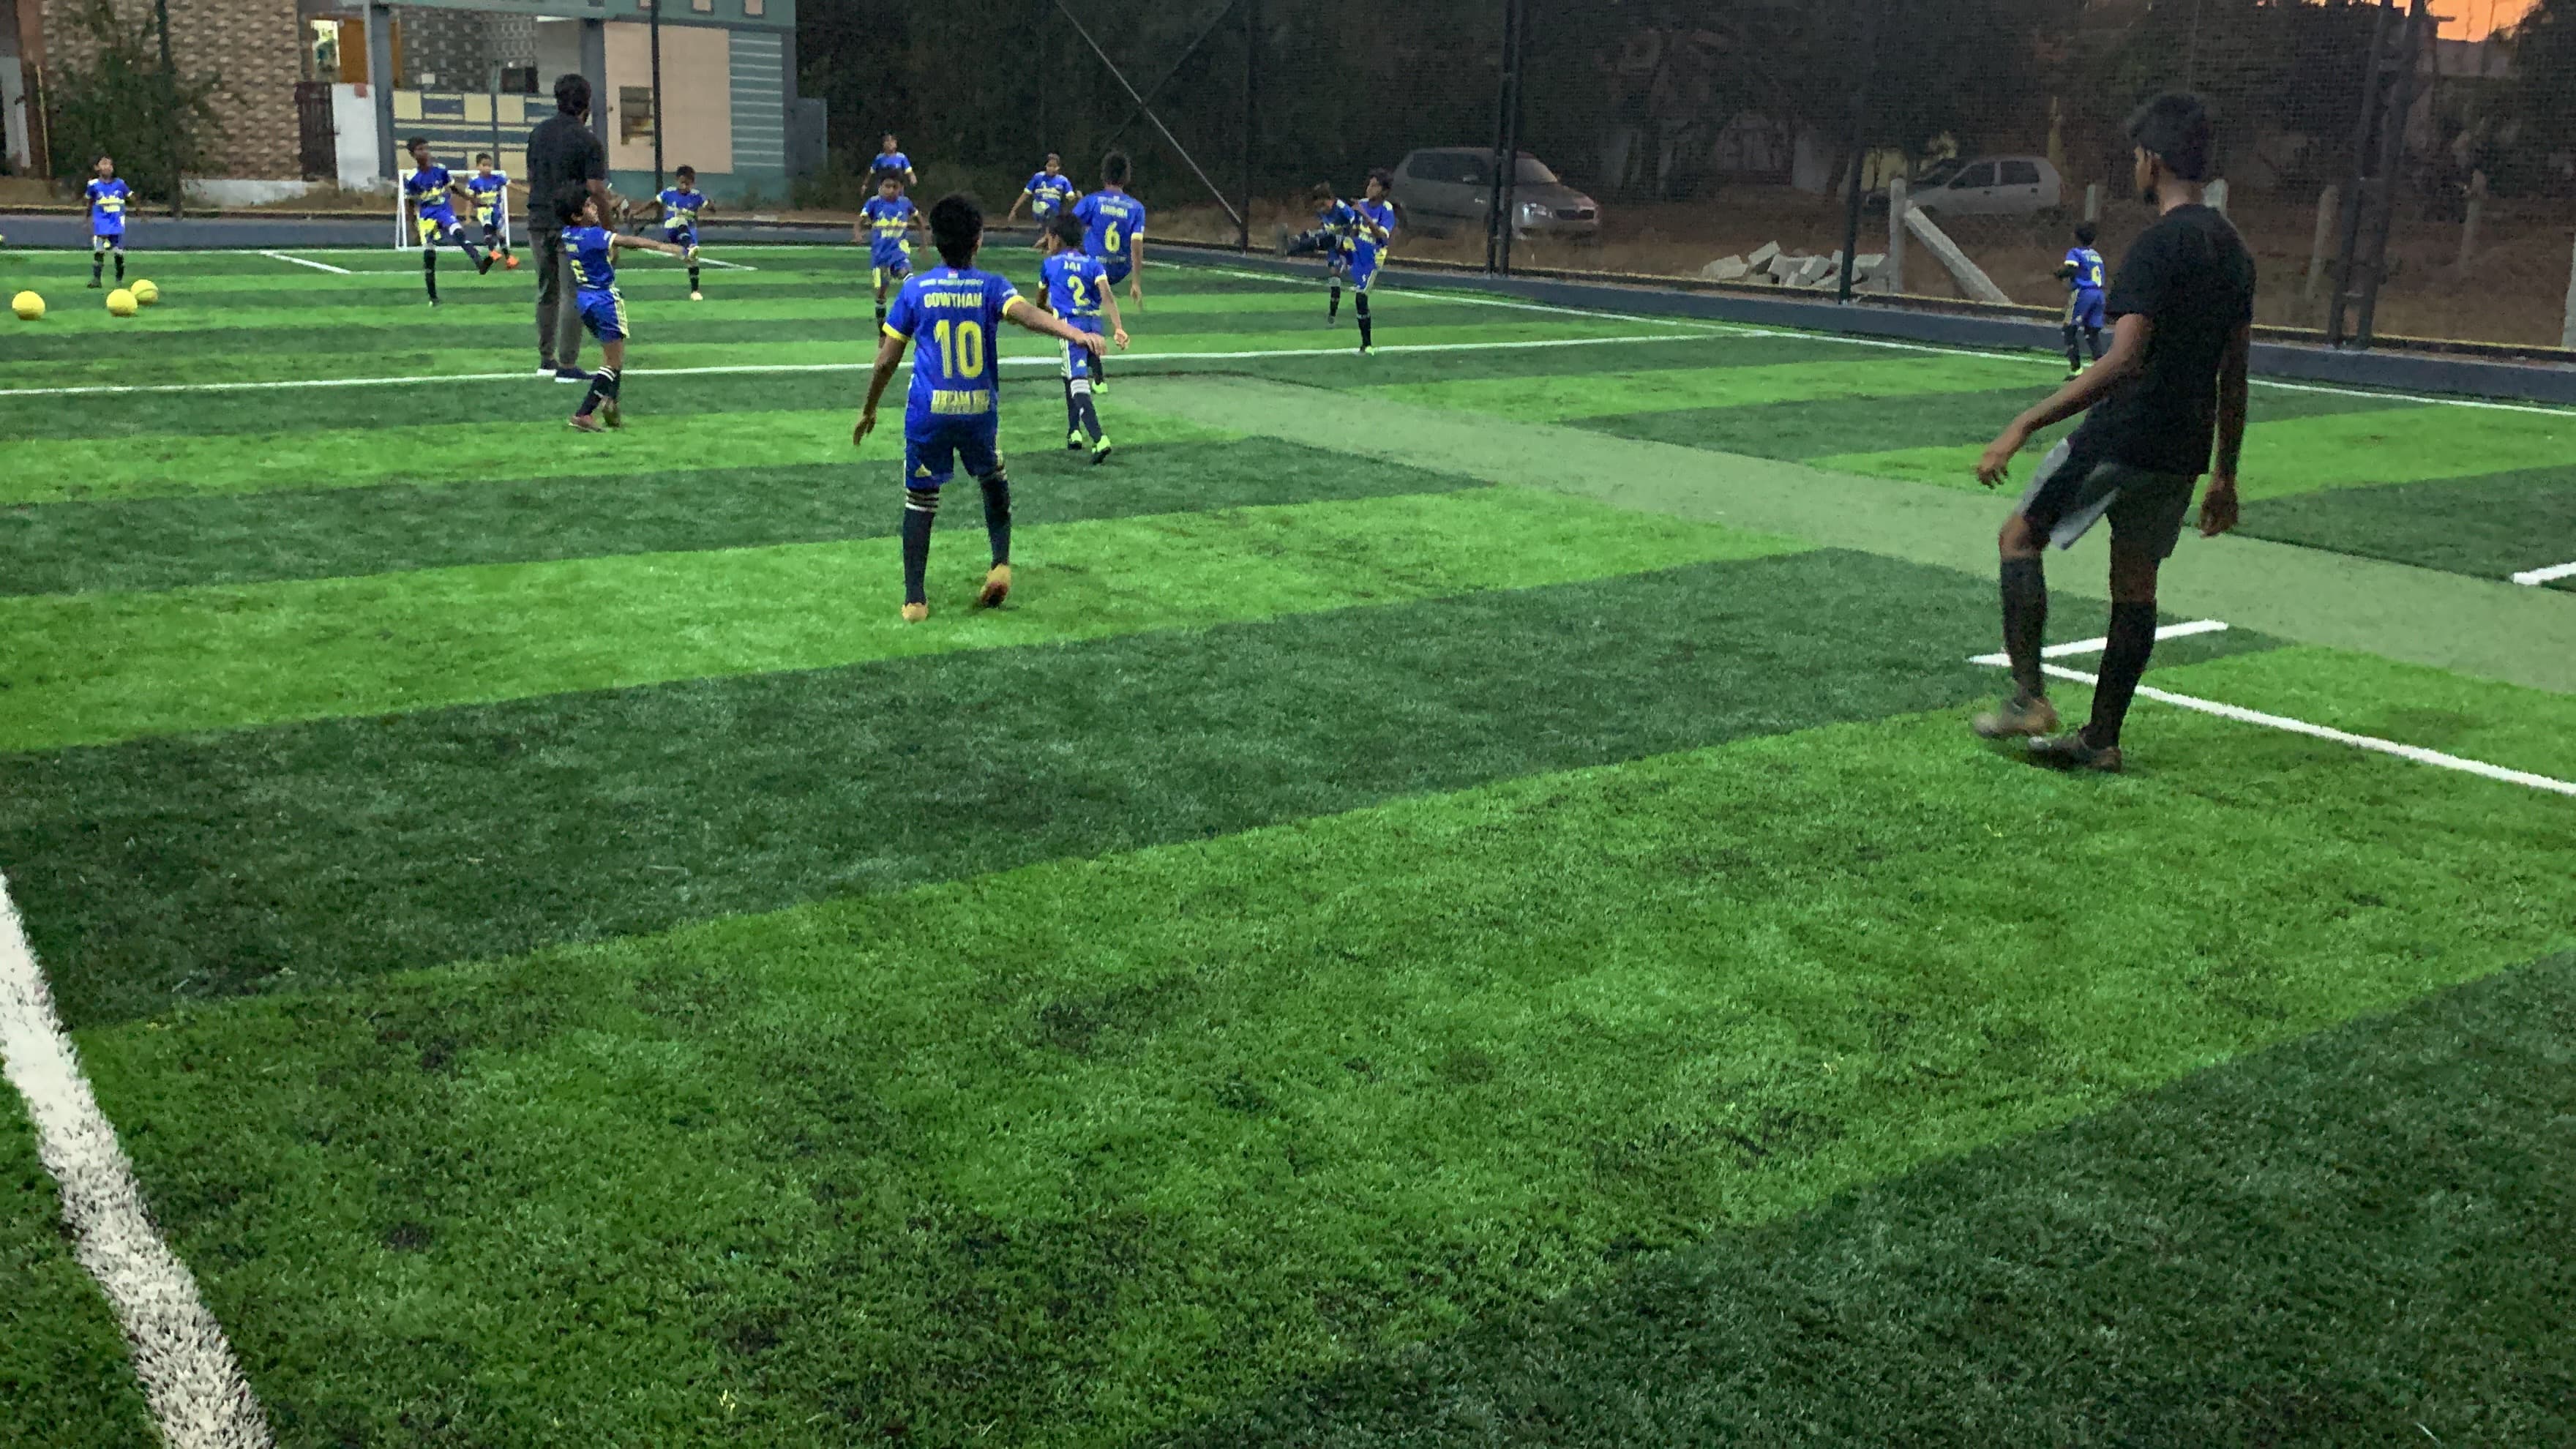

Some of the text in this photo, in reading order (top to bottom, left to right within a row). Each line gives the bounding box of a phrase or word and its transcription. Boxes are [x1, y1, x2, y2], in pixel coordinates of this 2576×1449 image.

[1104, 221, 1120, 252] 6
[1067, 274, 1090, 307] 2
[933, 319, 984, 378] 10
